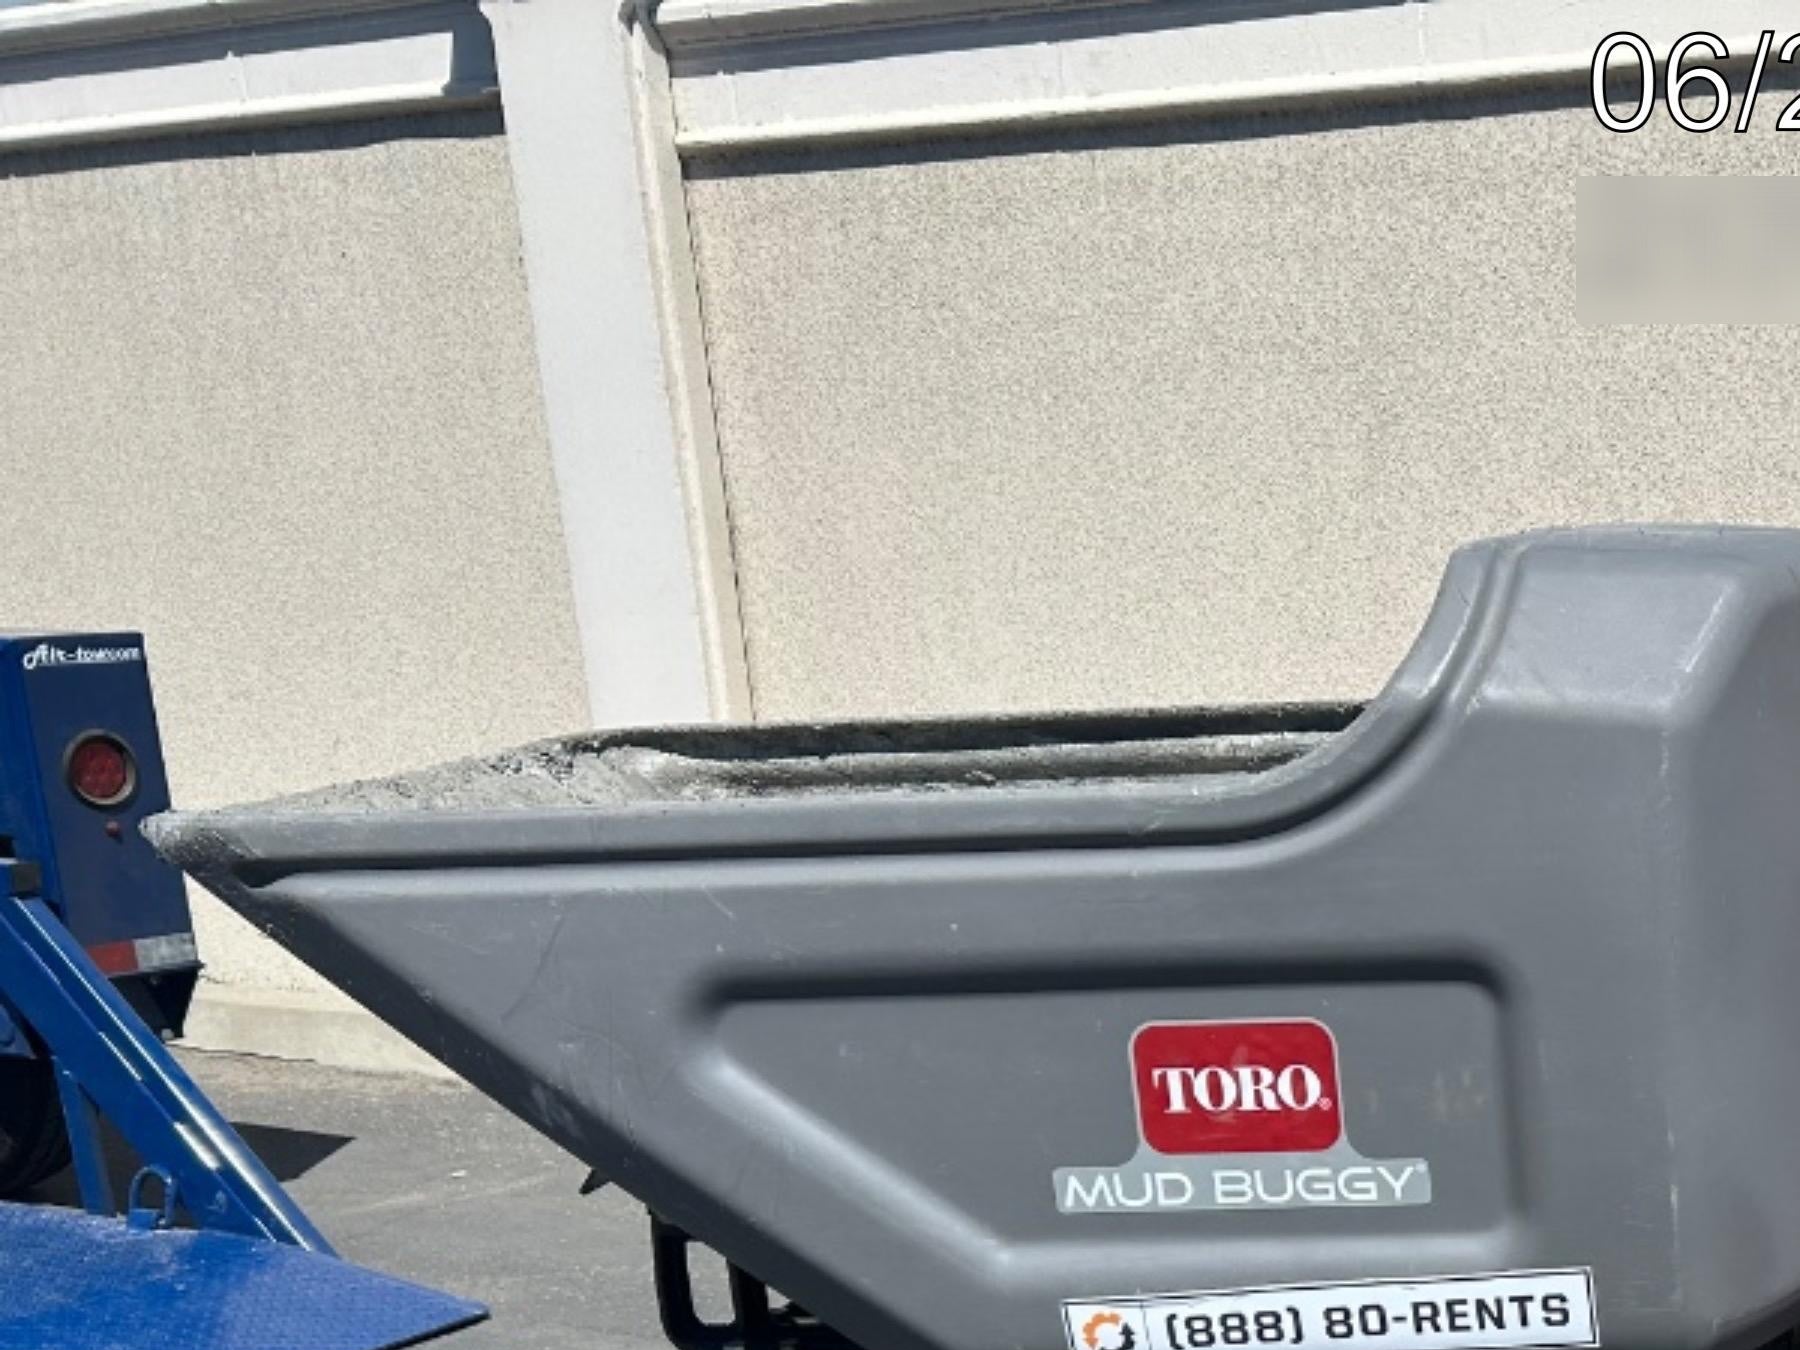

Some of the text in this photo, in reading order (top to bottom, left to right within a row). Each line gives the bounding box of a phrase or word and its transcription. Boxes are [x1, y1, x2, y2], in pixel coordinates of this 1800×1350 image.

[1064, 1165, 1416, 1208] MUD BUGGY
[1165, 1293, 1571, 1350] (888) 80-RENTS
